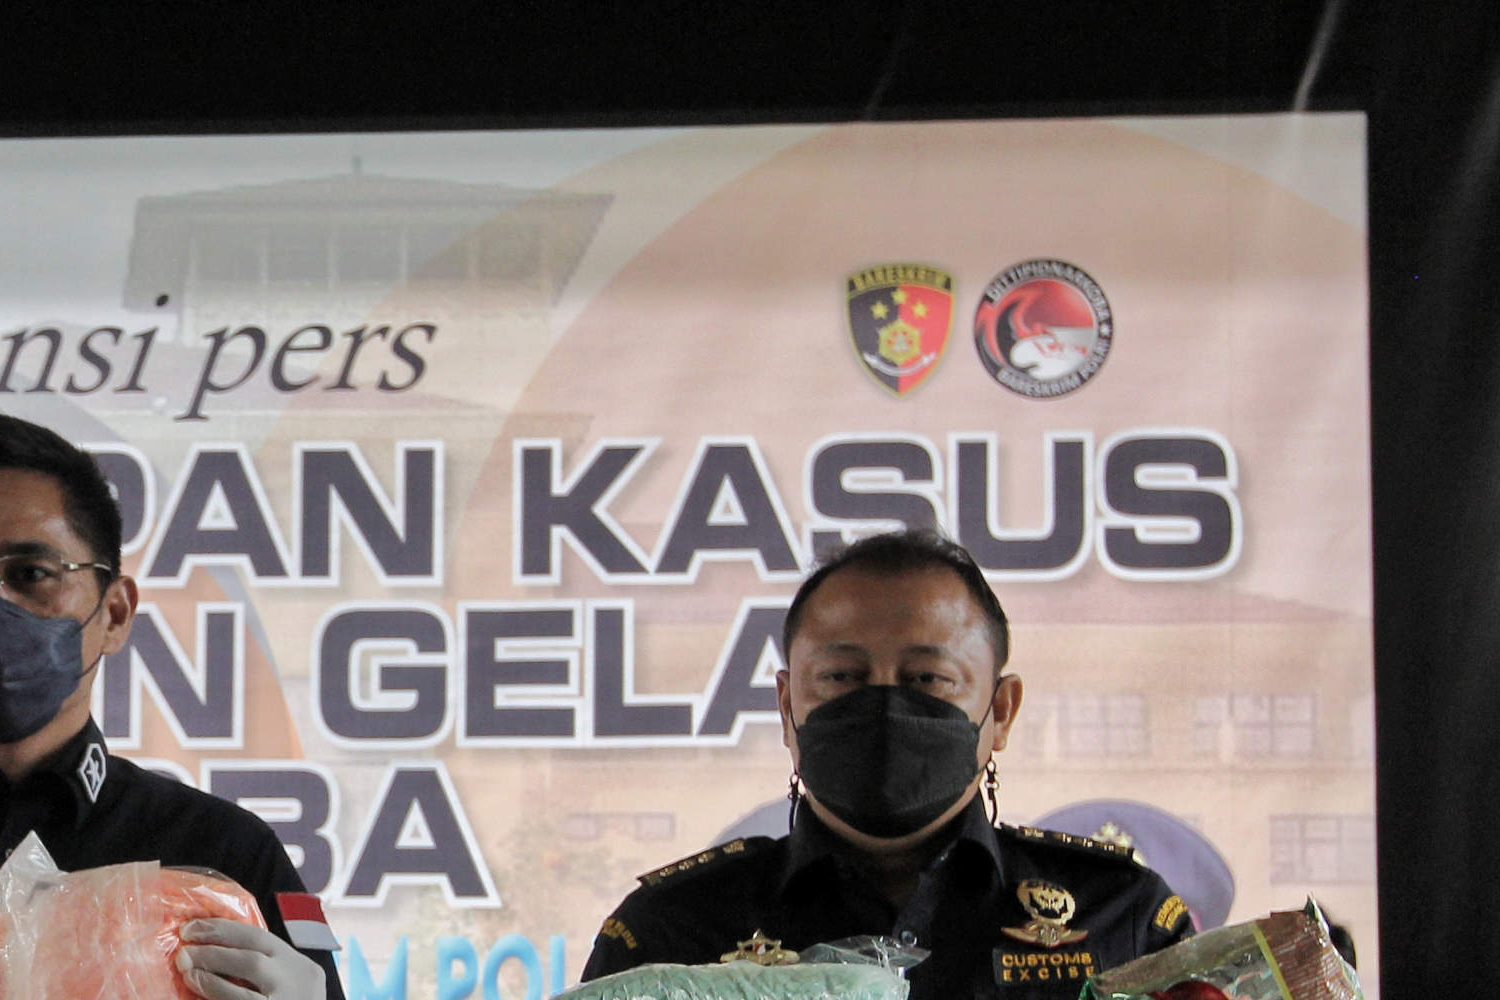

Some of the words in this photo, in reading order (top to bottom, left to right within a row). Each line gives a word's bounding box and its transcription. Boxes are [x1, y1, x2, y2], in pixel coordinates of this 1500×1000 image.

[177, 317, 438, 423] pers
[512, 426, 1241, 587] KASUS
[316, 597, 790, 751] GELA
[1001, 952, 1093, 967] CUSTOMS
[1002, 966, 1096, 983] EXCISE
